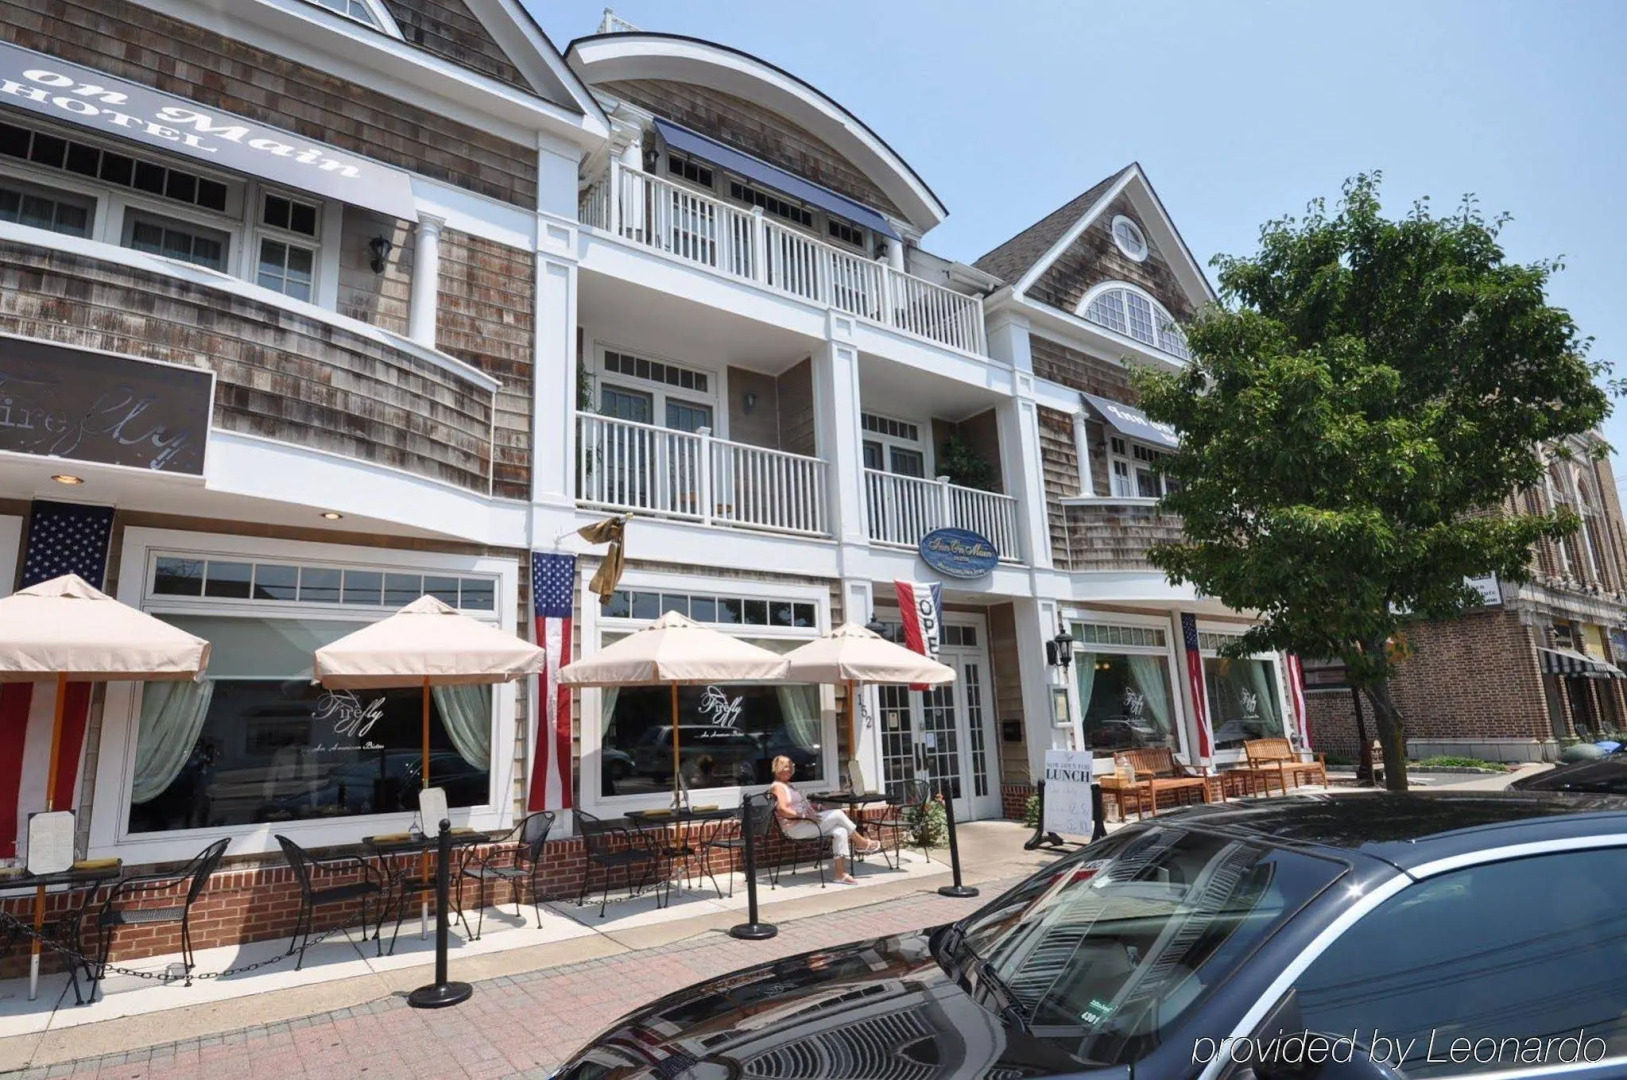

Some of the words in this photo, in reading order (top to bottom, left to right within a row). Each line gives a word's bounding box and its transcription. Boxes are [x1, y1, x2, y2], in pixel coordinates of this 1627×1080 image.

[0, 79, 218, 153] HOTEL
[22, 69, 128, 105] on
[156, 106, 361, 178] Main
[919, 599, 940, 662] OPE
[1046, 768, 1090, 783] LUNCH
